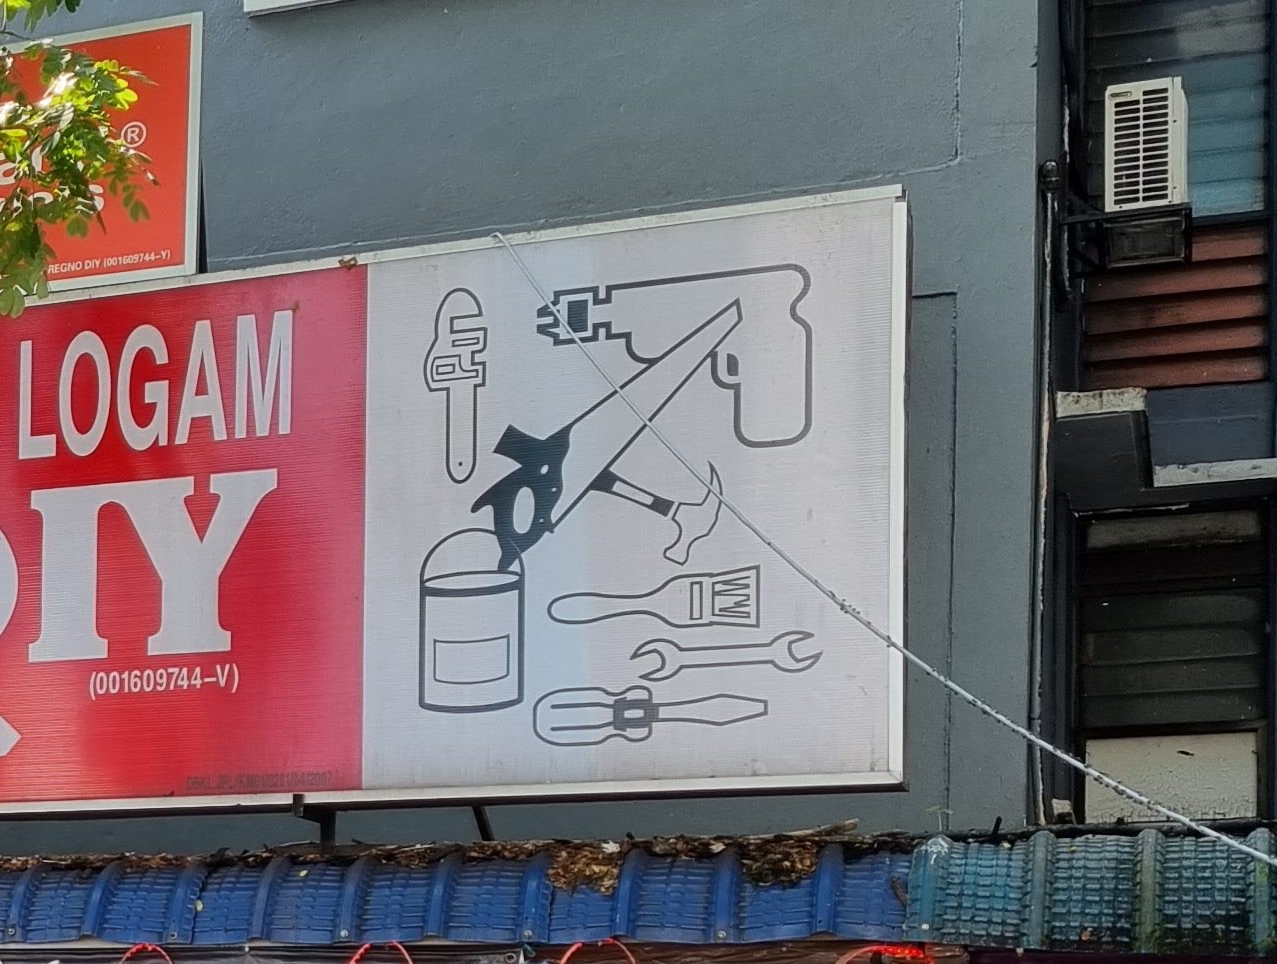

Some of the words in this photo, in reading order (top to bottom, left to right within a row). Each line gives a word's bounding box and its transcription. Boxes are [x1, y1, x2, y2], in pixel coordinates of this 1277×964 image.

[48, 262, 83, 275] REGNO
[85, 258, 102, 270] DIY
[17, 309, 293, 460] LOGAM
